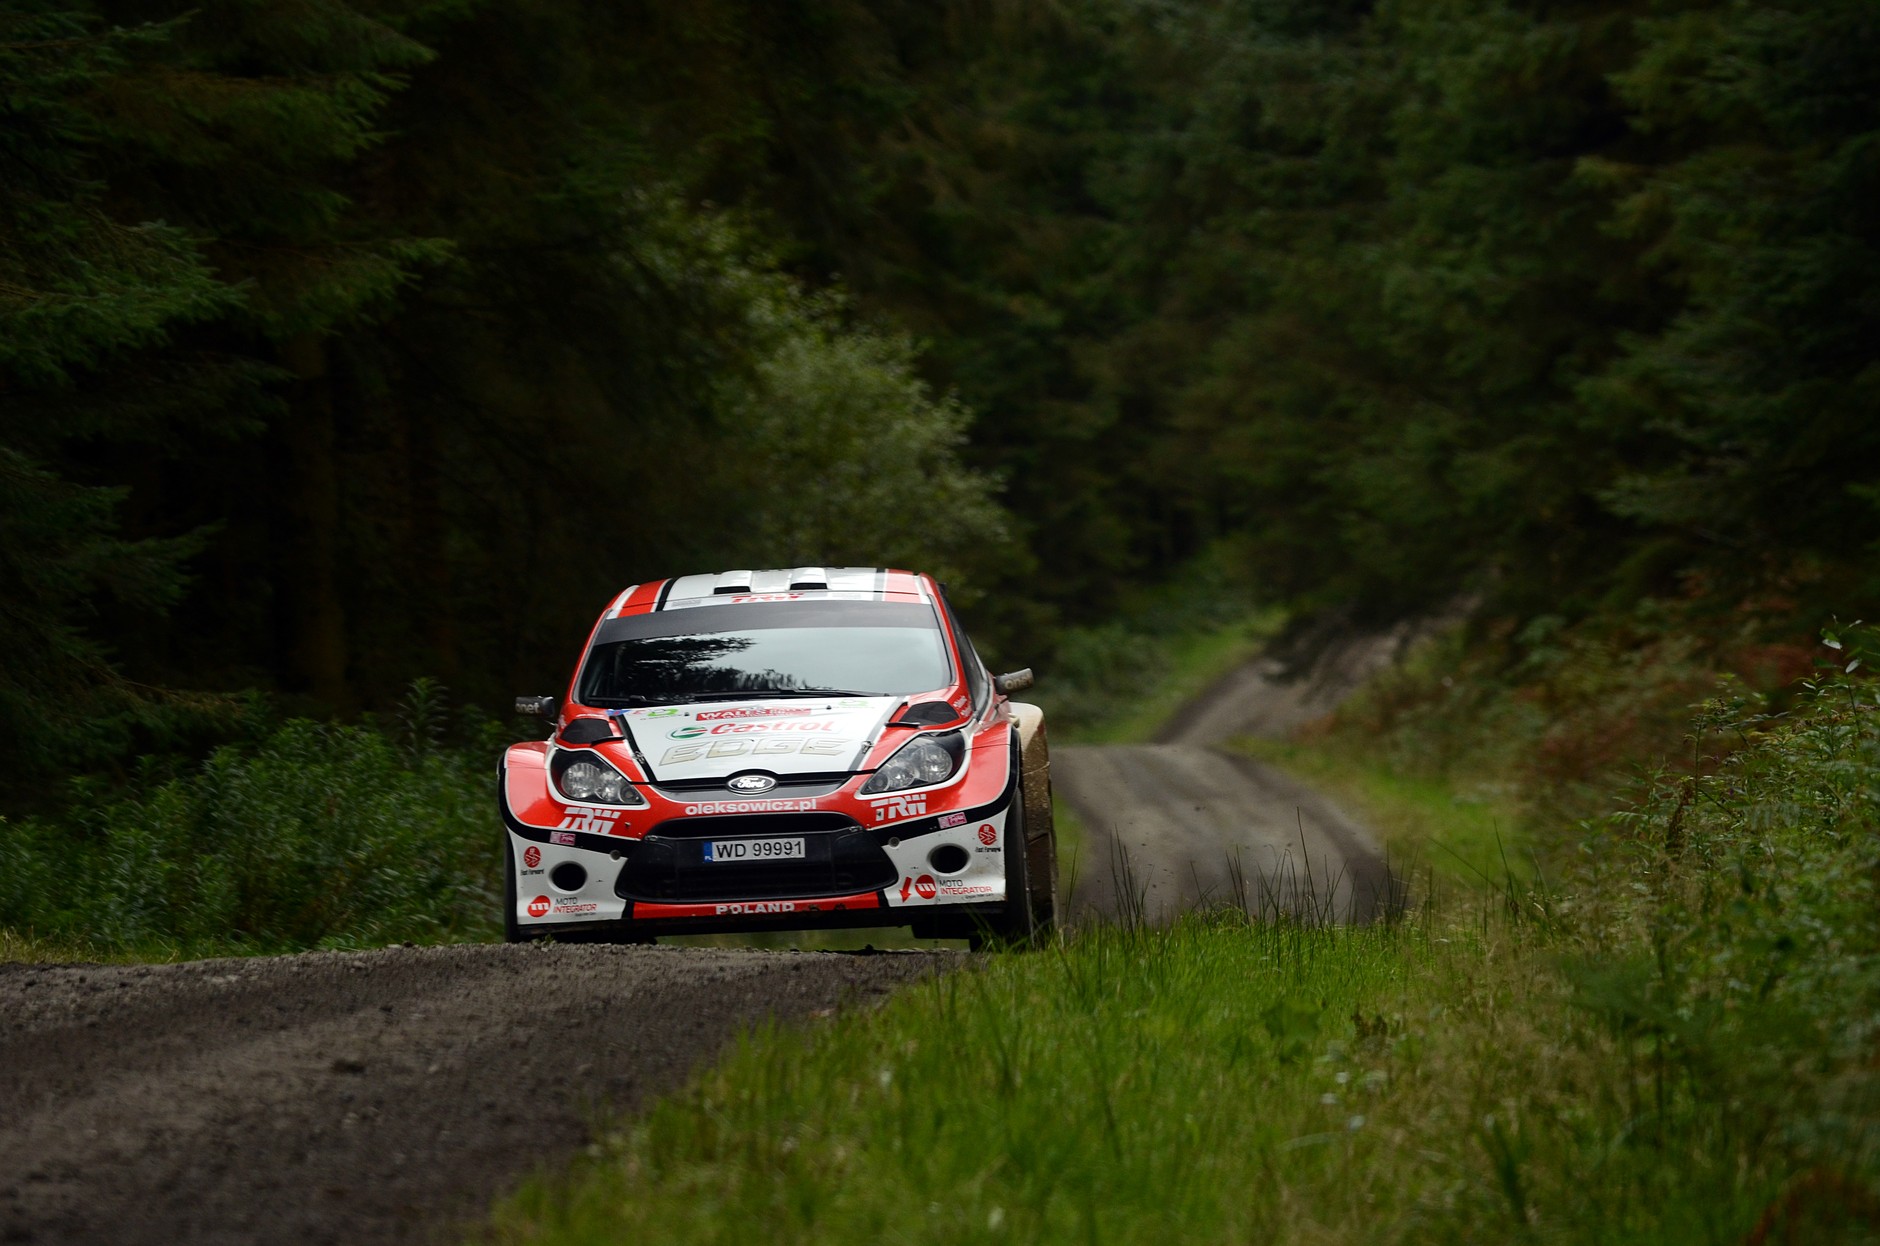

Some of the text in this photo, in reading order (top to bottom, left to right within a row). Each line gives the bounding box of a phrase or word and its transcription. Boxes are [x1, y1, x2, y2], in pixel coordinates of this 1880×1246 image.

[701, 708, 767, 719] WALES
[711, 721, 835, 735] Castrol
[659, 736, 854, 766] EDGE
[737, 777, 766, 789] Ford
[685, 799, 817, 816] oleksowicz.pl
[870, 794, 927, 821] TRW
[556, 807, 622, 835] TRW
[716, 841, 803, 859] WD 99991
[939, 879, 963, 887] MOTO
[940, 886, 993, 895] INTEGRATOR
[555, 897, 578, 905] MOTO
[553, 903, 597, 914] INTEGRATOR
[715, 902, 795, 915] POLAND
